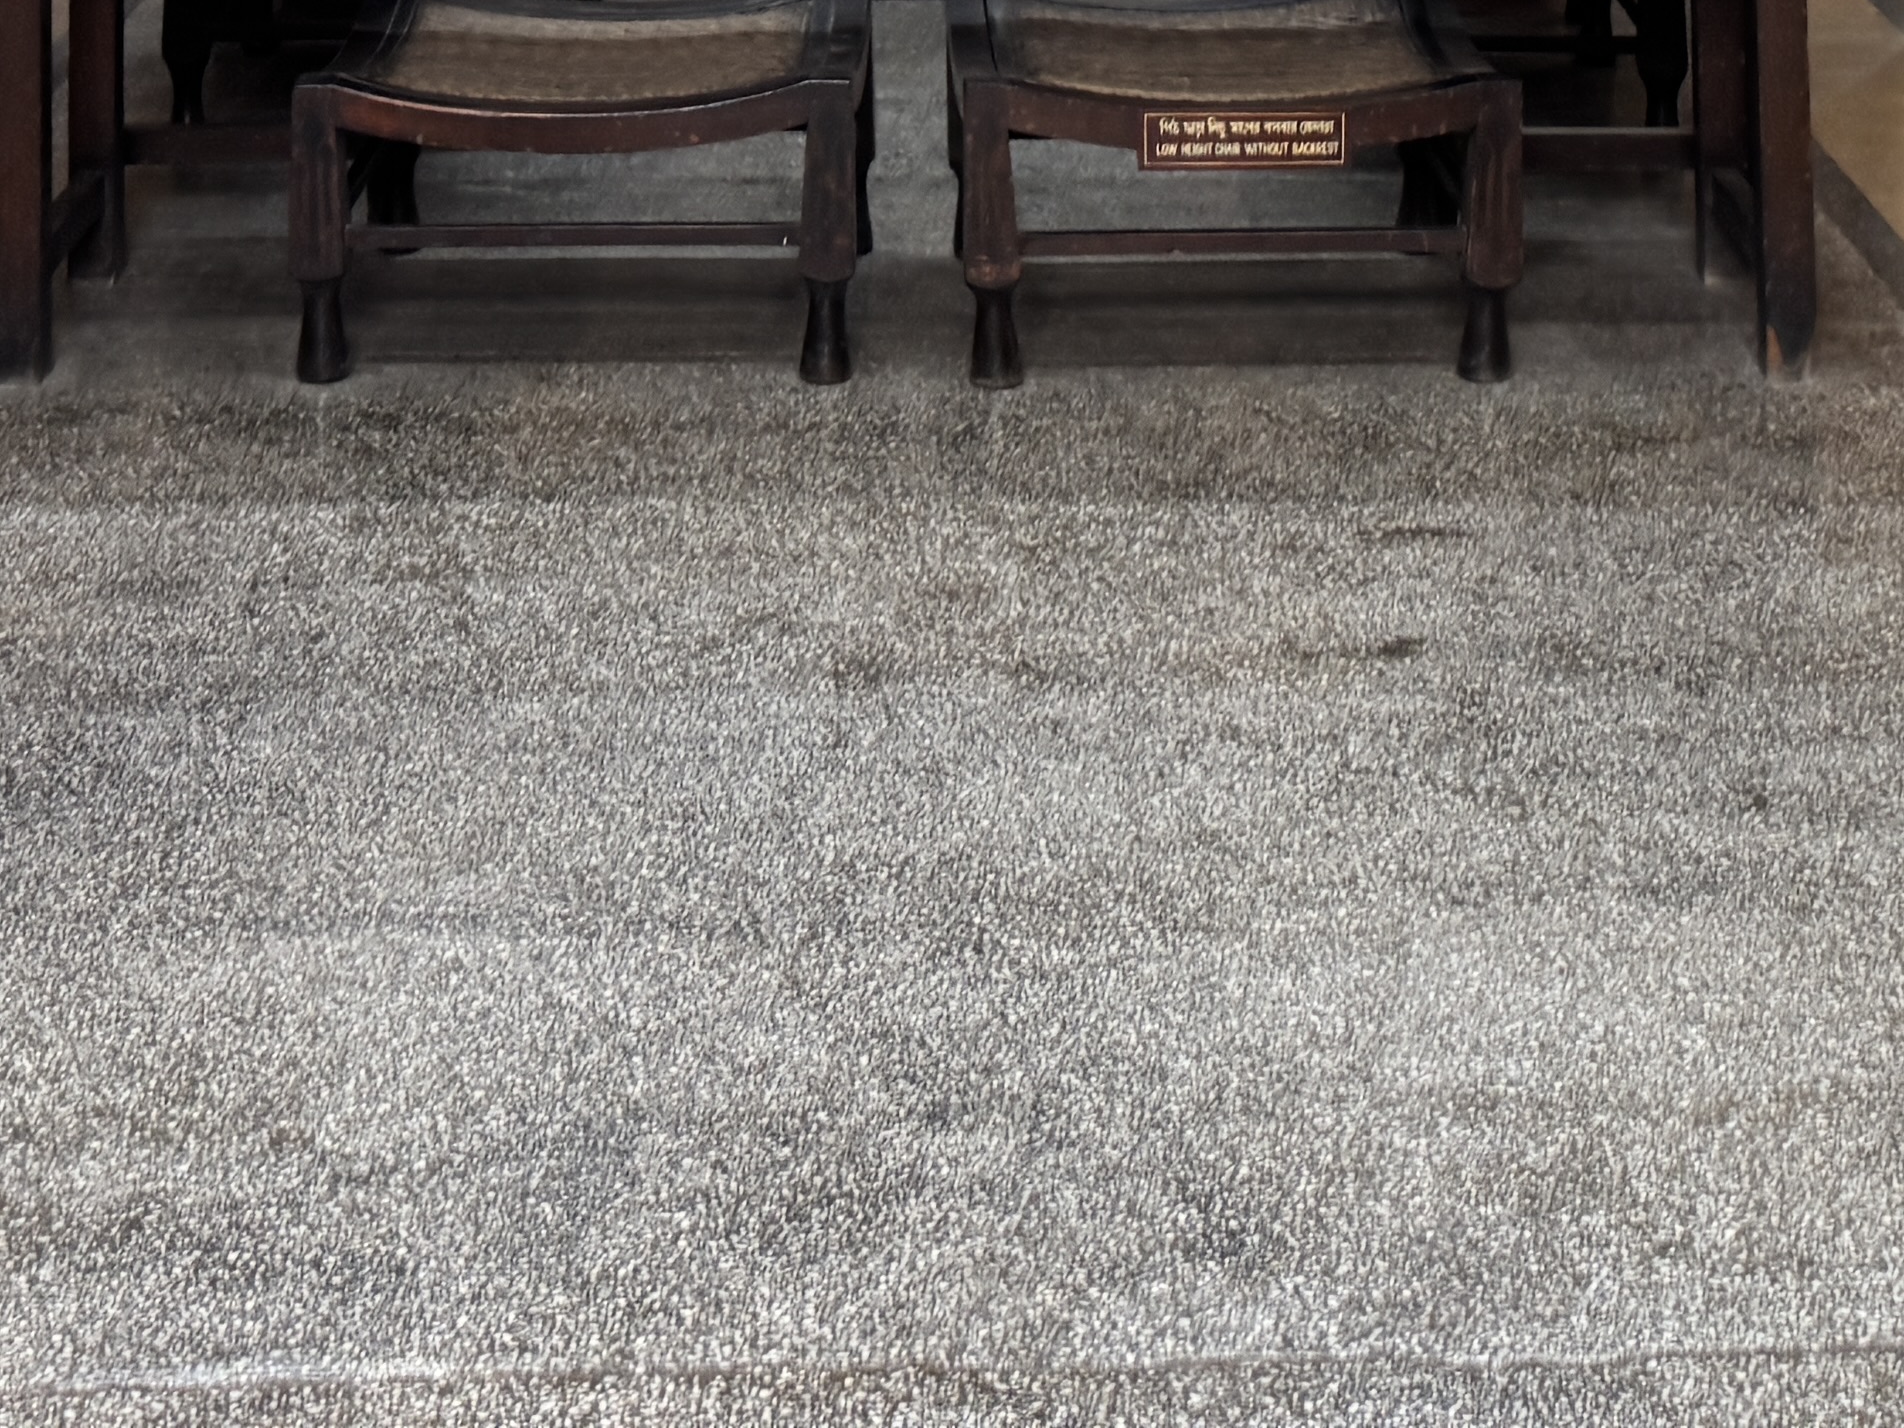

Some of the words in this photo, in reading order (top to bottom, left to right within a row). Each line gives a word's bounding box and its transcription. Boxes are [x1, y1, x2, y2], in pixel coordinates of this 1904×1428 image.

[1156, 142, 1178, 156] LOW
[1180, 141, 1212, 156] HEIGHT
[1214, 141, 1241, 156] CHAIR
[1244, 141, 1289, 156] WITHOUT
[1292, 140, 1339, 156] BACKREST
